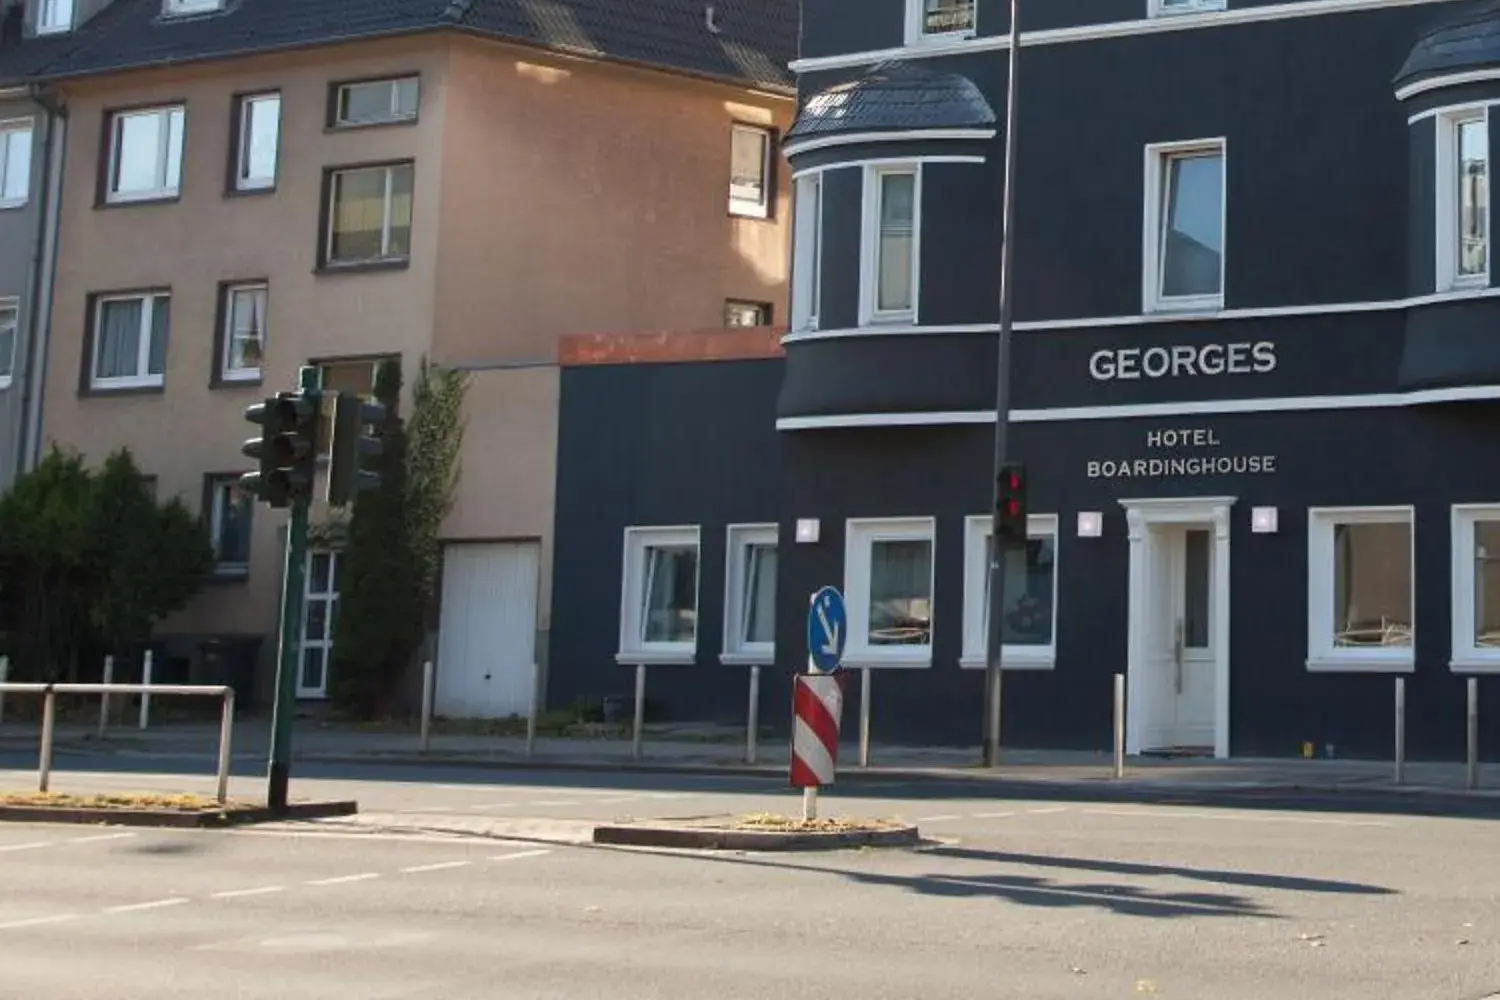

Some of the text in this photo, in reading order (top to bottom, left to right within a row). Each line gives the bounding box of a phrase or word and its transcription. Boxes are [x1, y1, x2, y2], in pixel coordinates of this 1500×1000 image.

[1089, 342, 1277, 380] GEORGES
[1147, 429, 1220, 447] HOTEL
[1087, 456, 1276, 478] BOARDINGHOUSE
